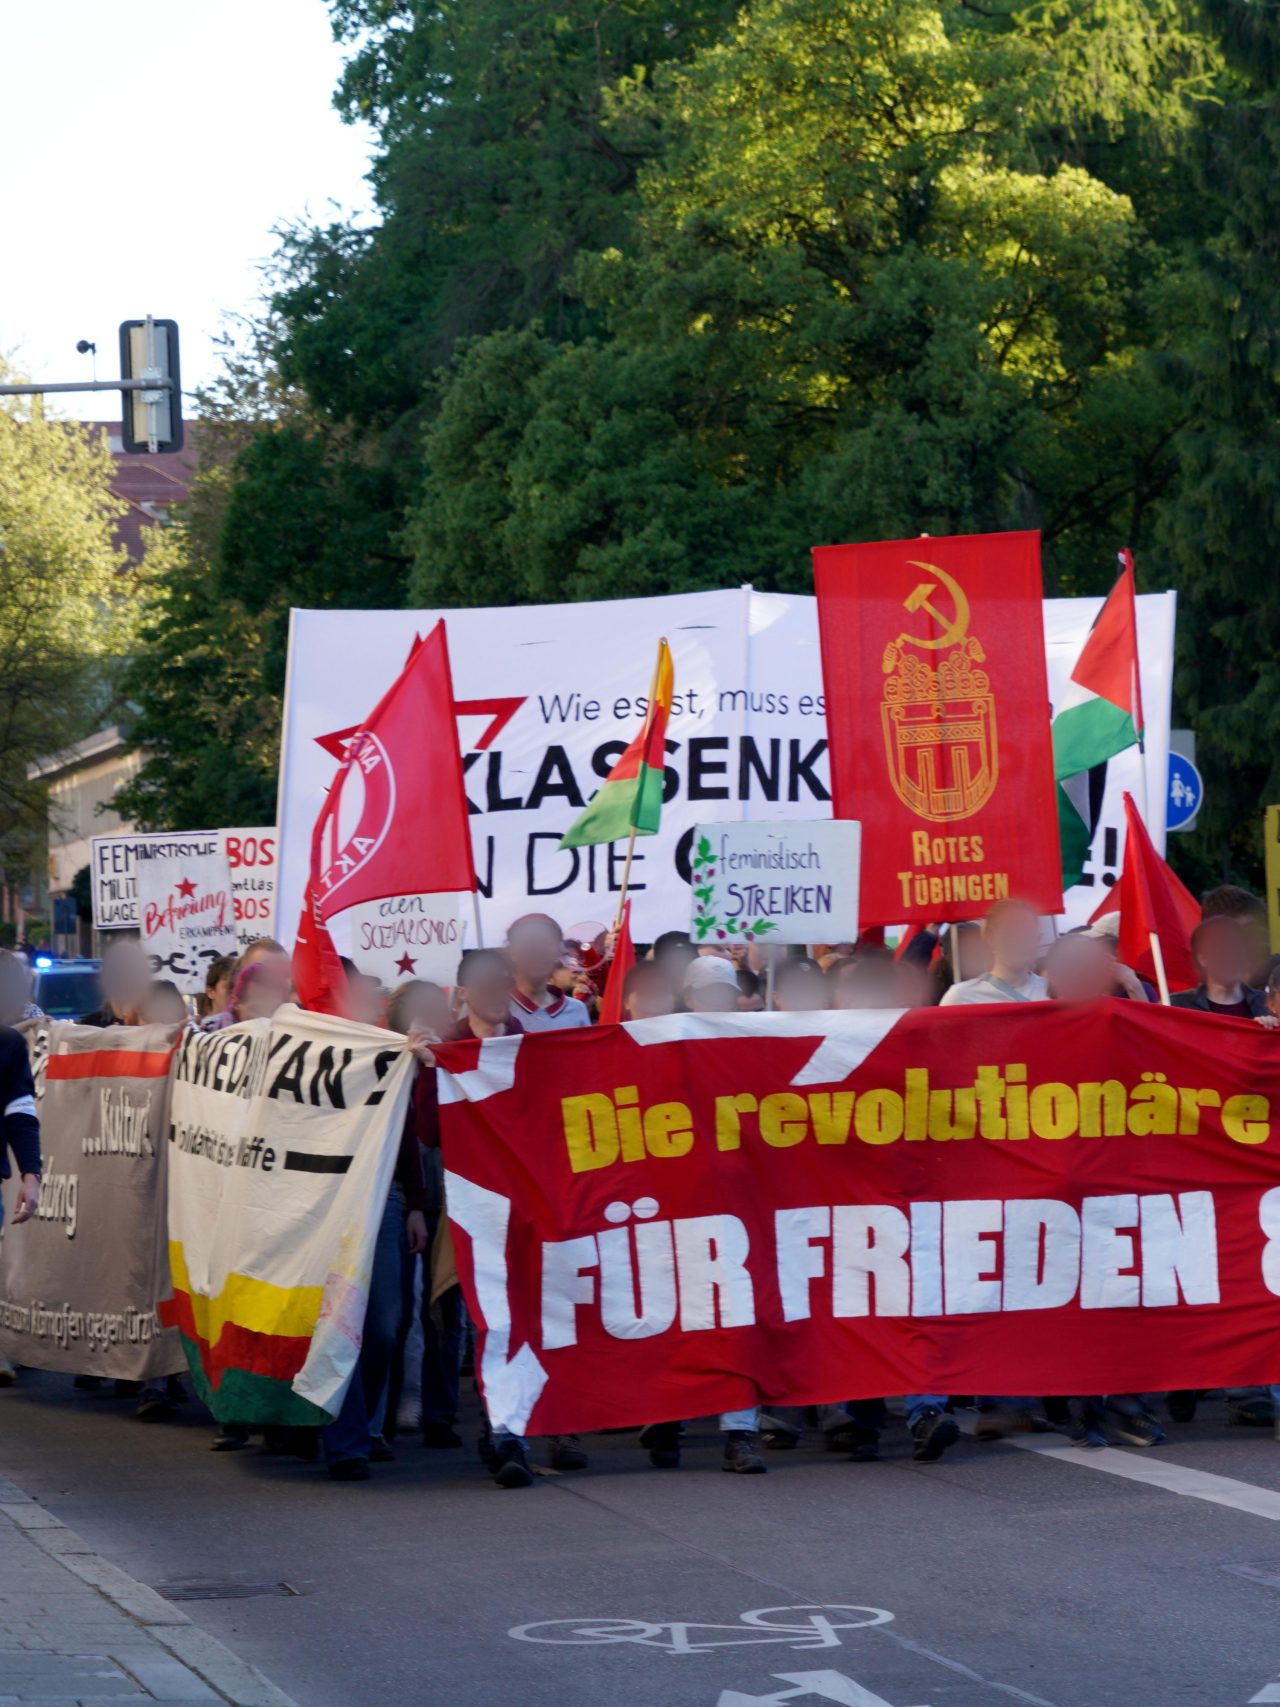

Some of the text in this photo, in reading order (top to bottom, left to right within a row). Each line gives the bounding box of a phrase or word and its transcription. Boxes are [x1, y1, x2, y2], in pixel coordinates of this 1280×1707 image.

[539, 693, 601, 724] Wie
[612, 696, 648, 720] es
[669, 689, 706, 719] st,
[718, 690, 789, 715] muss
[225, 837, 275, 868] BOS
[526, 832, 647, 896] DIE
[719, 833, 821, 875] feministisch
[379, 896, 424, 917] den
[725, 883, 832, 917] STREIKEN
[897, 872, 1009, 908] TÜBINGEN
[100, 903, 138, 922] WAGE
[232, 897, 271, 920] BOS
[561, 1086, 693, 1173] Die
[715, 1063, 1270, 1151] revolutionäre
[541, 1196, 757, 1350] FÜR
[774, 1190, 1221, 1323] FRIEDEN
